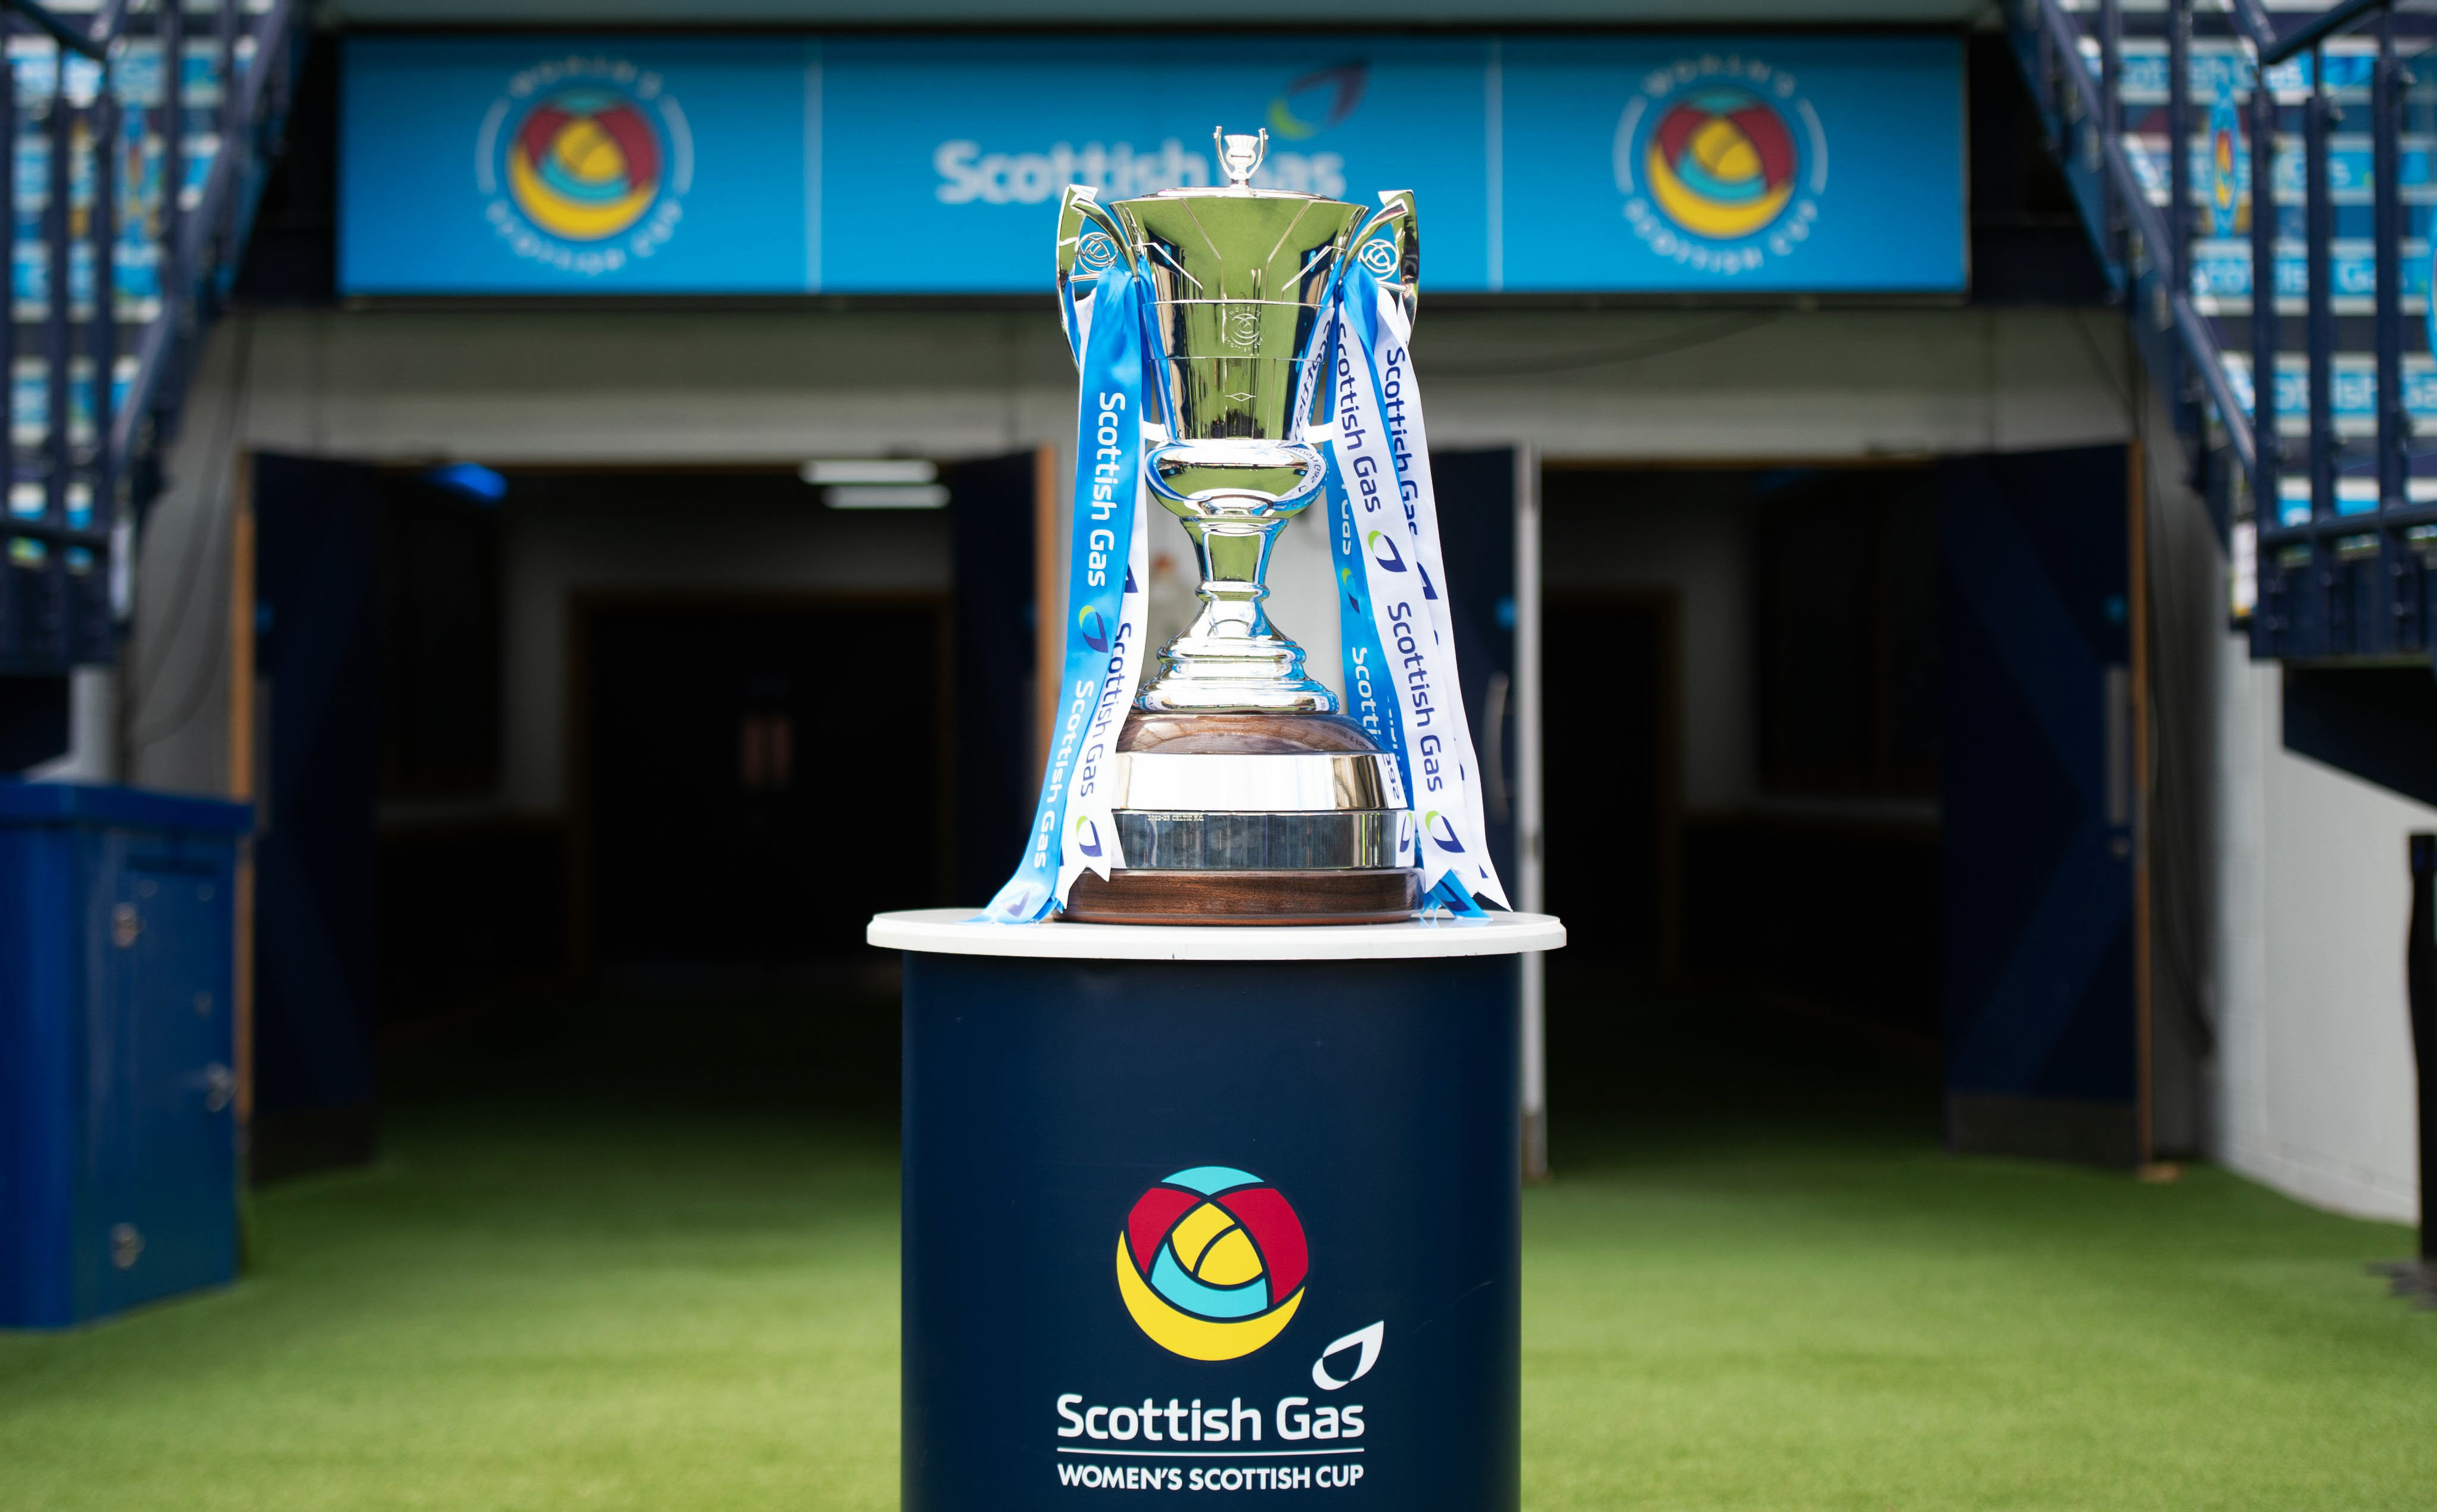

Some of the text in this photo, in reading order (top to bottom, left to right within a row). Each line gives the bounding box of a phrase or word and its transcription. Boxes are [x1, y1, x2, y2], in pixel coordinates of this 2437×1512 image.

[933, 139, 1208, 204] Scottish
[1087, 392, 1126, 587] Scottish Gas
[1353, 456, 1381, 513] Gas
[1081, 623, 1131, 797] Scottish Gas
[1352, 646, 1382, 739] Scotti
[1387, 601, 1436, 727] Scottish
[1420, 735, 1443, 792] Gas
[1034, 680, 1094, 869] Scottish Gas
[1056, 1392, 1365, 1442] Scottish Gas
[1057, 1463, 1364, 1491] WOMEN'S SCOTTISH CUP
